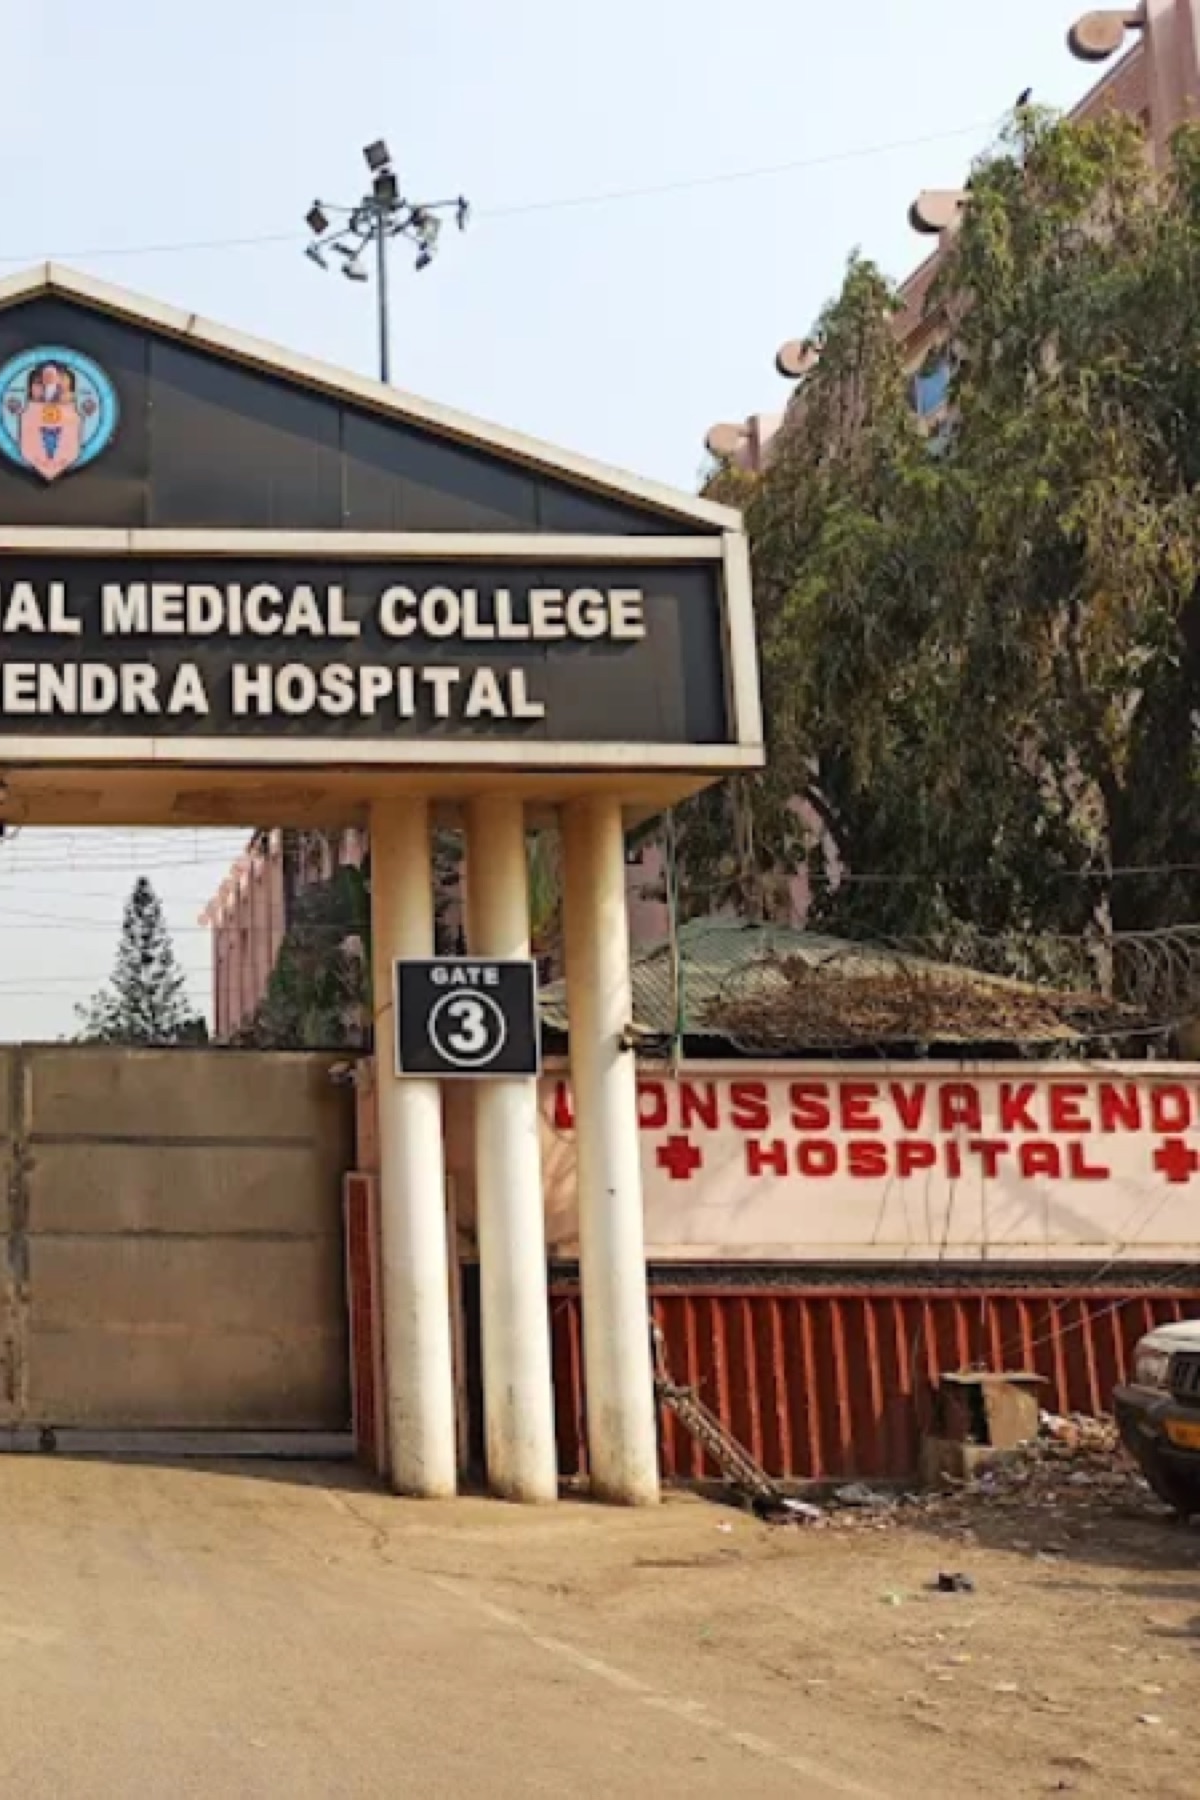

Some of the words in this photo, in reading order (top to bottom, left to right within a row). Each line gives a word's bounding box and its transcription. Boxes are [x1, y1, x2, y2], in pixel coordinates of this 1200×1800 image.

[102, 583, 360, 637] MEDICAL
[380, 587, 645, 641] COLLEGE
[231, 664, 545, 719] HOSPITAL
[430, 966, 500, 986] GATE
[447, 1000, 488, 1053] 3
[555, 1081, 769, 1130] LONS
[790, 1083, 982, 1132] SEVA
[1001, 1083, 1200, 1132] KEND
[746, 1140, 1111, 1179] HOSPITAL
